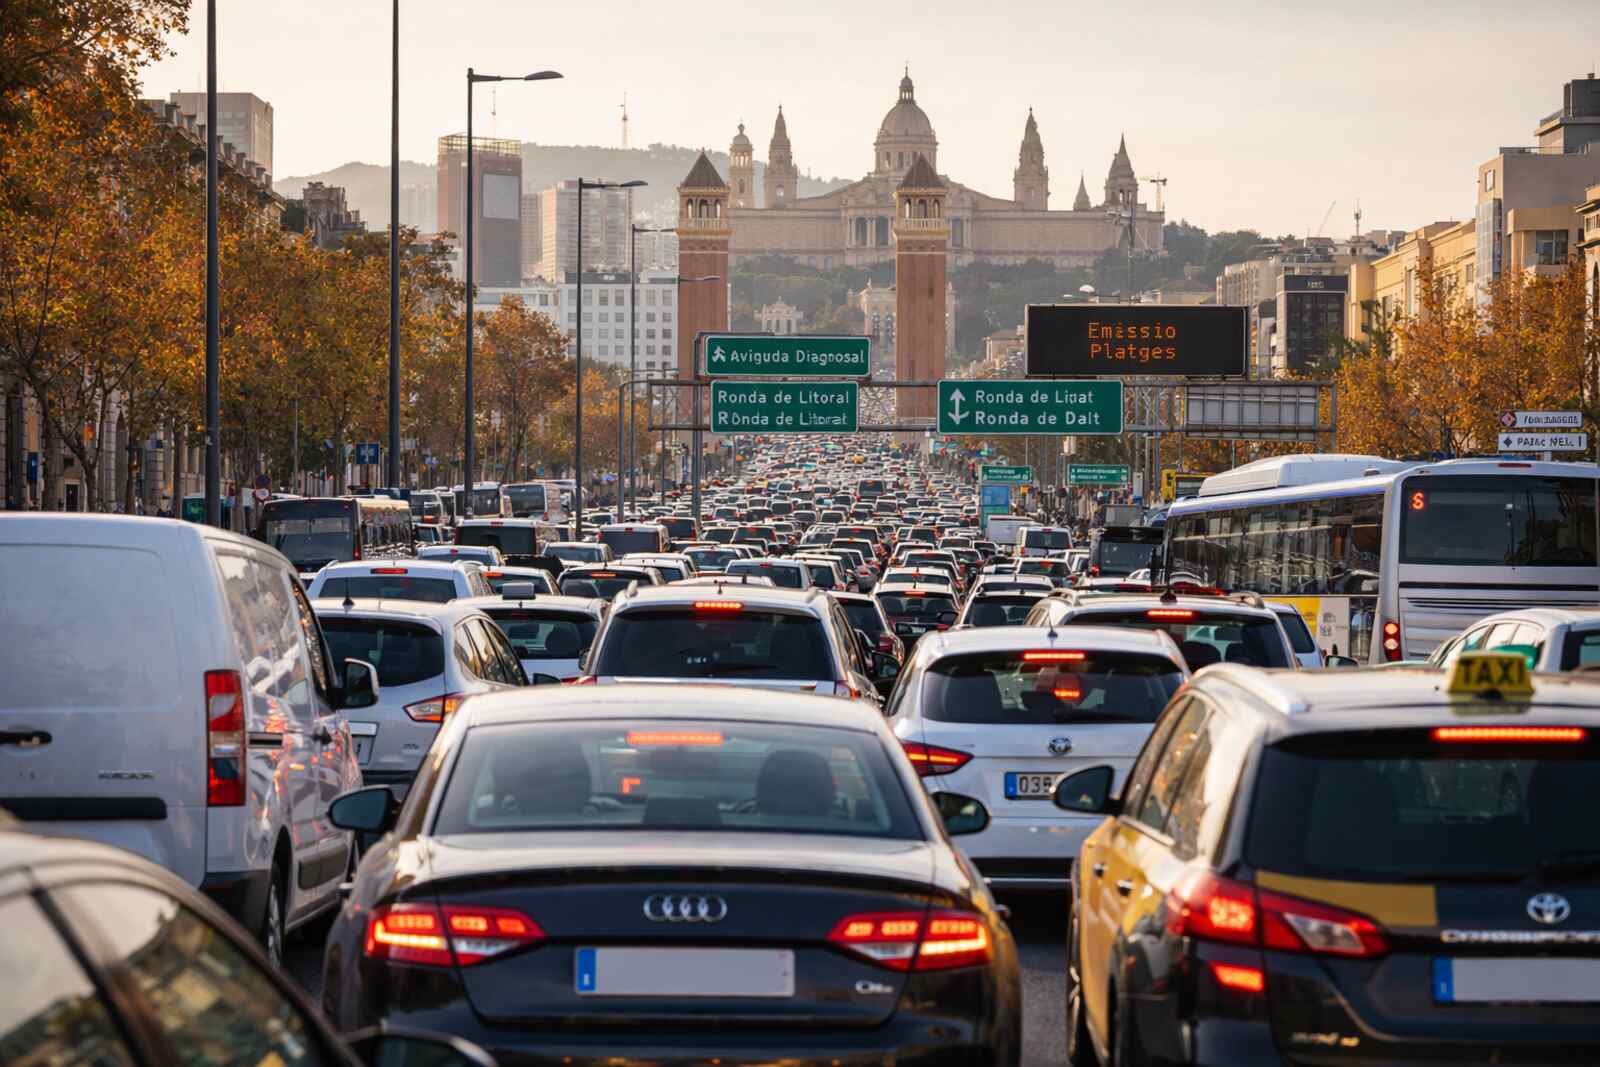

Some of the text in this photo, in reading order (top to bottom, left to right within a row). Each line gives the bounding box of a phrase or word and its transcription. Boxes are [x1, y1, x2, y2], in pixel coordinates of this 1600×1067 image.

[731, 349, 789, 364] Aviguda
[1090, 344, 1176, 362] Platges
[718, 390, 849, 404] Ronda de Litoral
[975, 390, 1024, 404] Ronda
[1030, 390, 1049, 404] de
[776, 411, 793, 426] de
[975, 411, 1100, 425] Ronda de Dalt
[1412, 491, 1425, 511] S
[1458, 656, 1524, 685] TAXI
